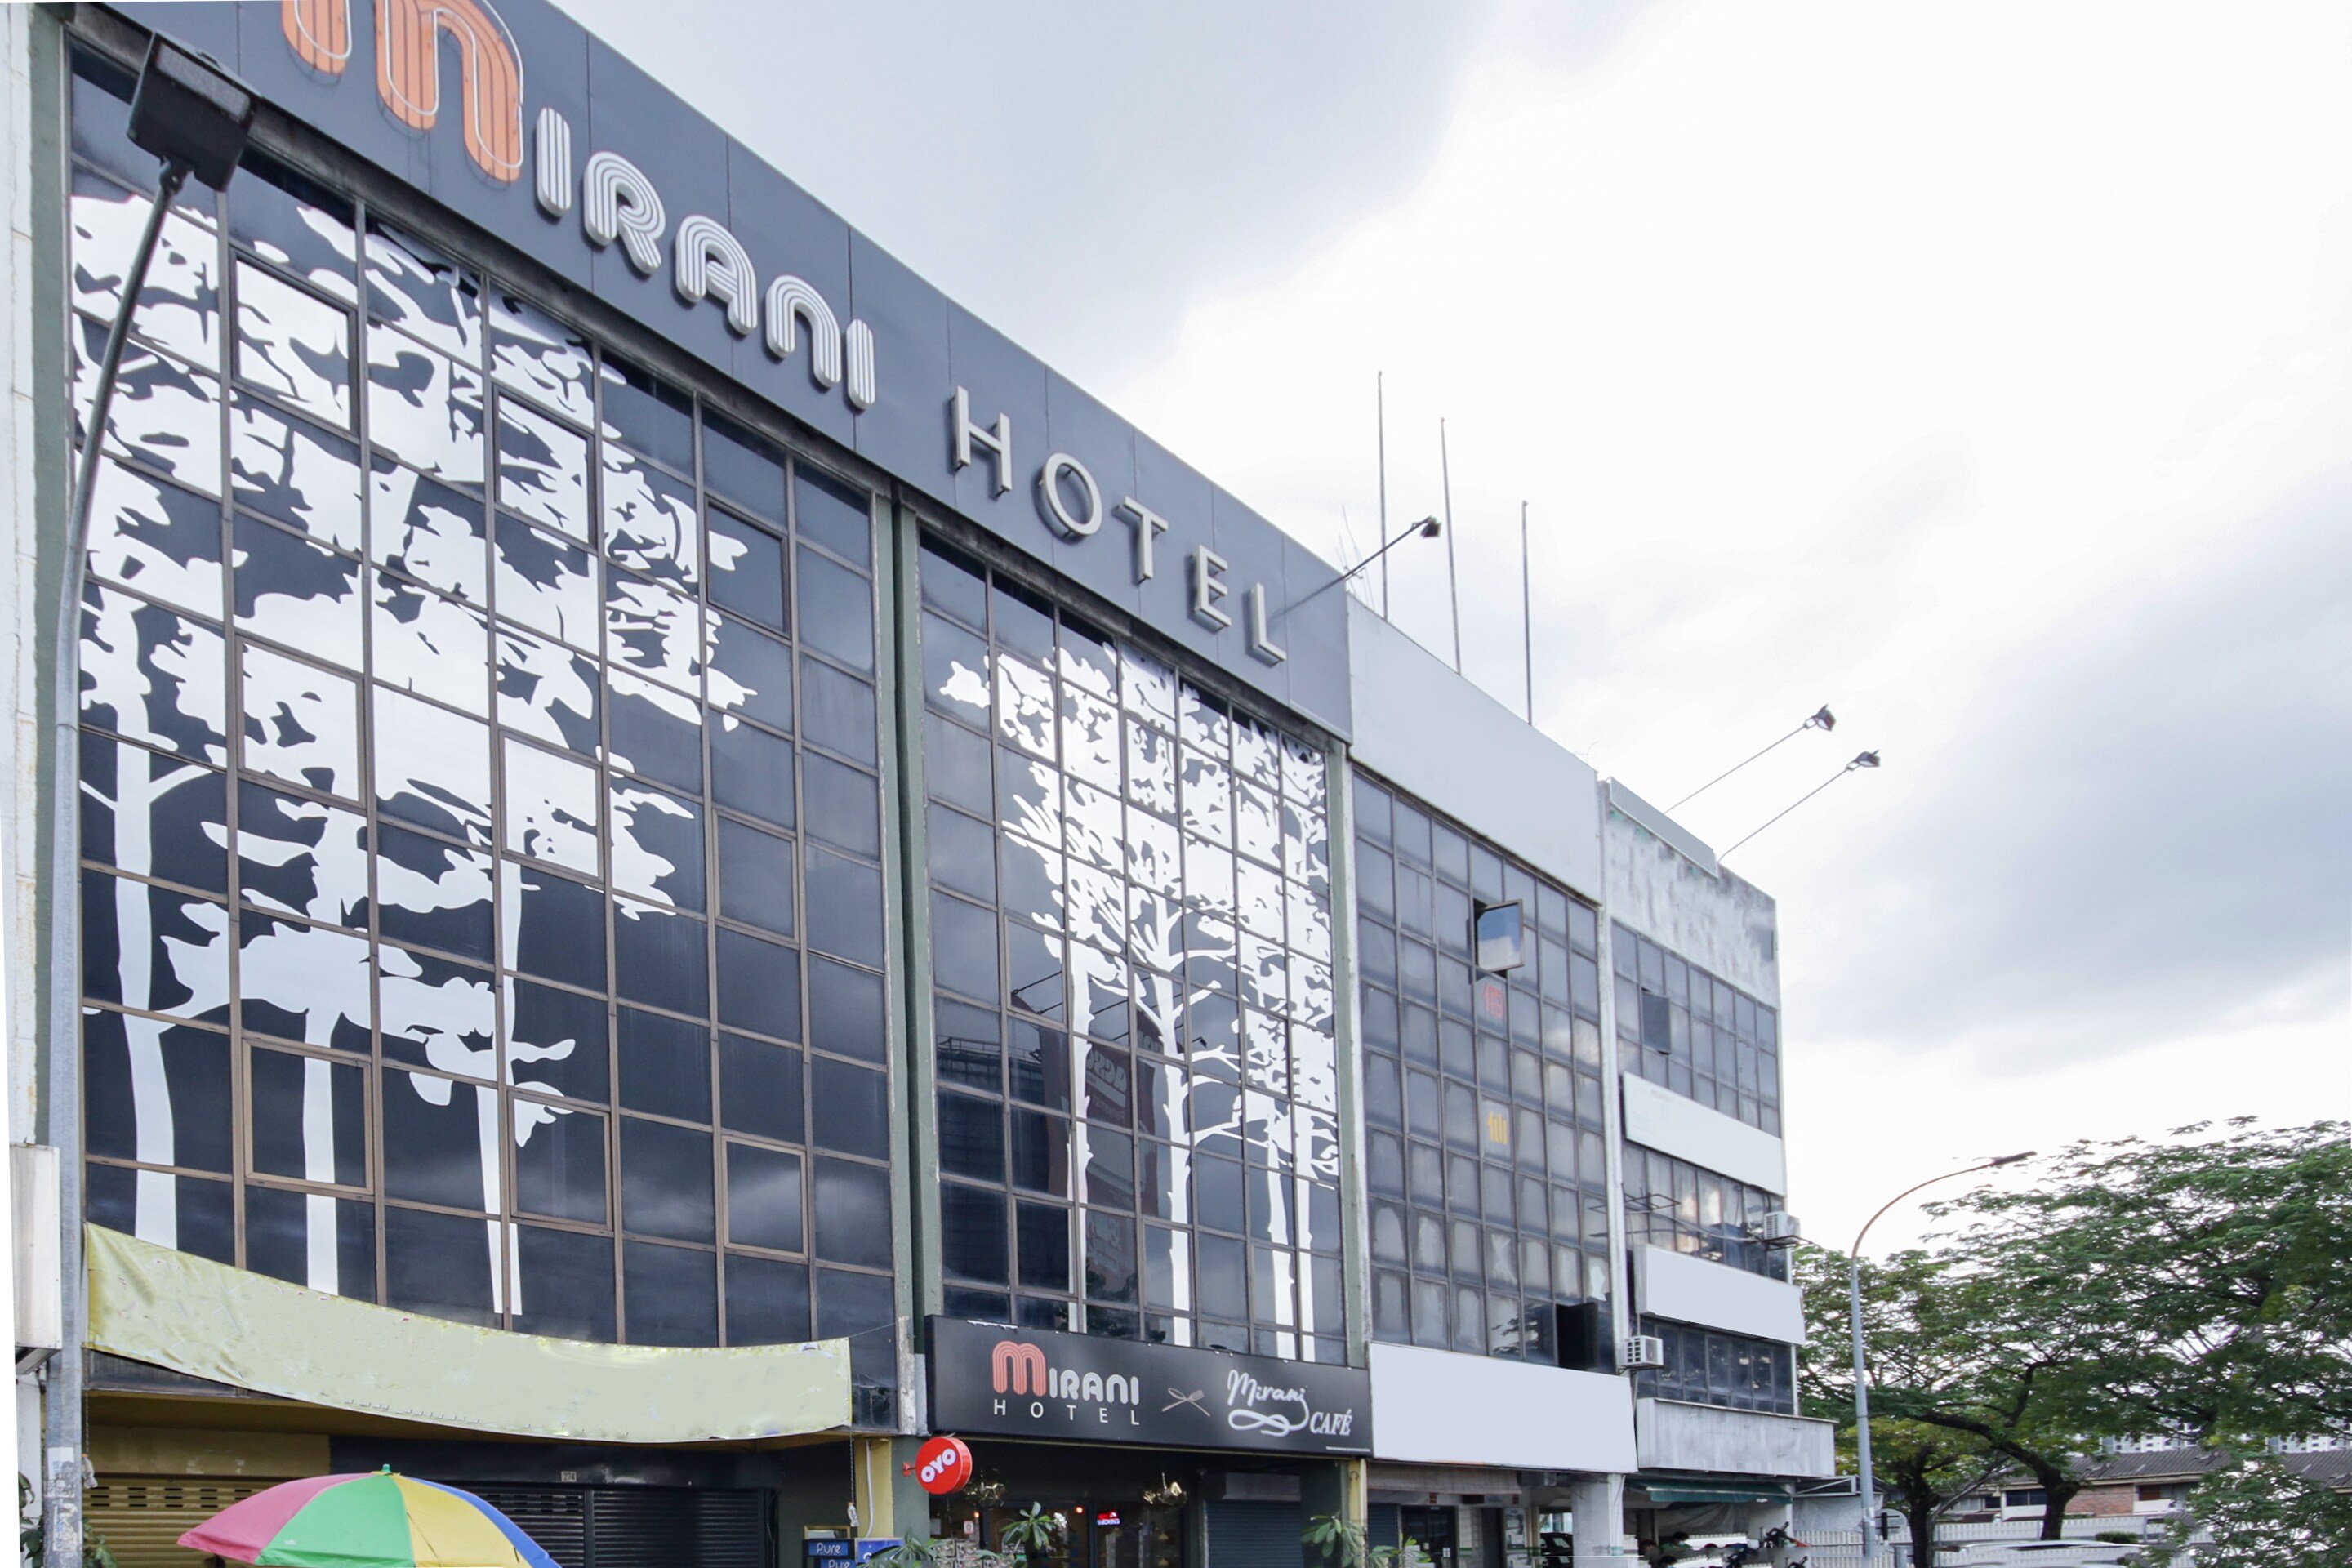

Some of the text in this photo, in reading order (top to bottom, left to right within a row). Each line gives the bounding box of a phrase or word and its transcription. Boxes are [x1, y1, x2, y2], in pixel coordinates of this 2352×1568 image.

[949, 385, 1288, 667] HOTEL
[992, 1340, 1140, 1405] MIRANI
[1227, 1369, 1309, 1410] Mirani
[993, 1398, 1140, 1426] HOTEL
[1309, 1409, 1353, 1437] CAFÉ
[564, 1472, 576, 1481] 274
[920, 1448, 957, 1483] OYO
[817, 1542, 841, 1554] Pure
